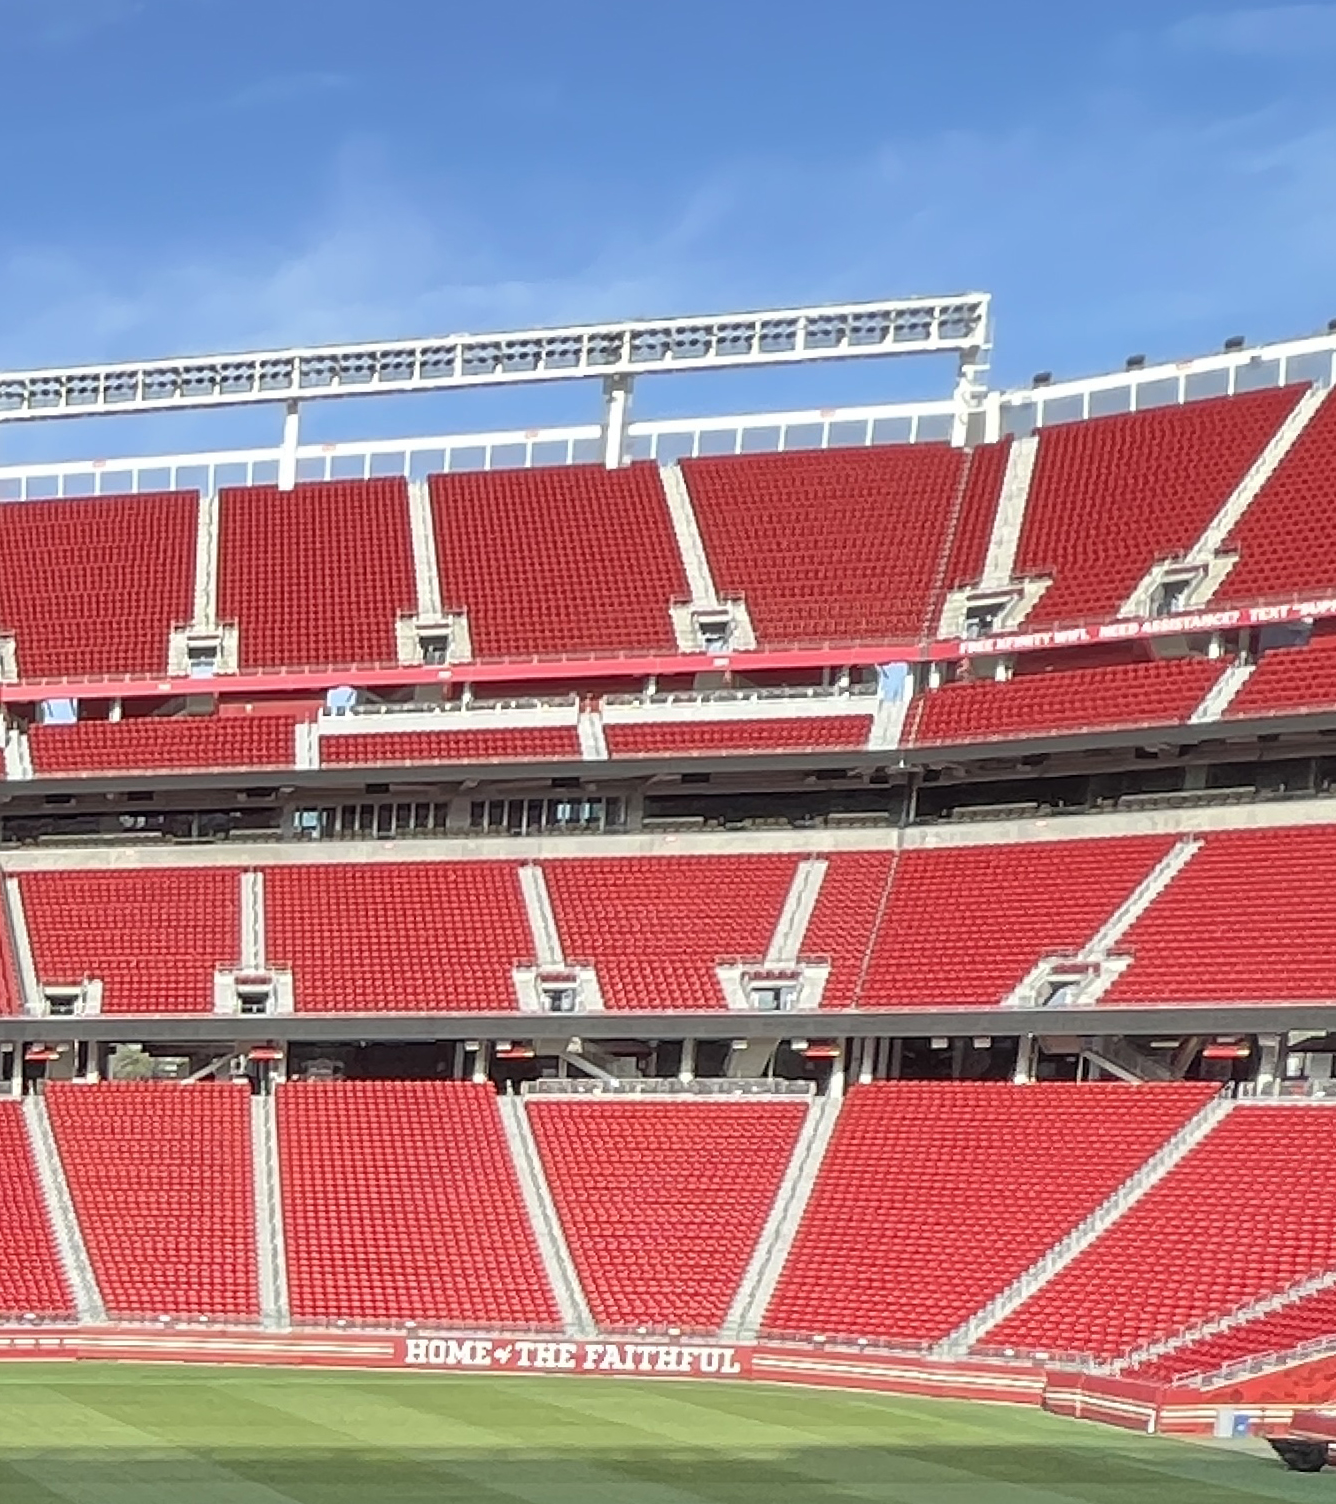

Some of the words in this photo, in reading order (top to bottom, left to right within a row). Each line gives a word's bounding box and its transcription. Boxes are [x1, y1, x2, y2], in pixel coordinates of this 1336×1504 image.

[1249, 605, 1290, 623] TEXT
[405, 1339, 491, 1365] HOME
[516, 1342, 576, 1369] THE
[582, 1344, 741, 1373] FAITHFUL
